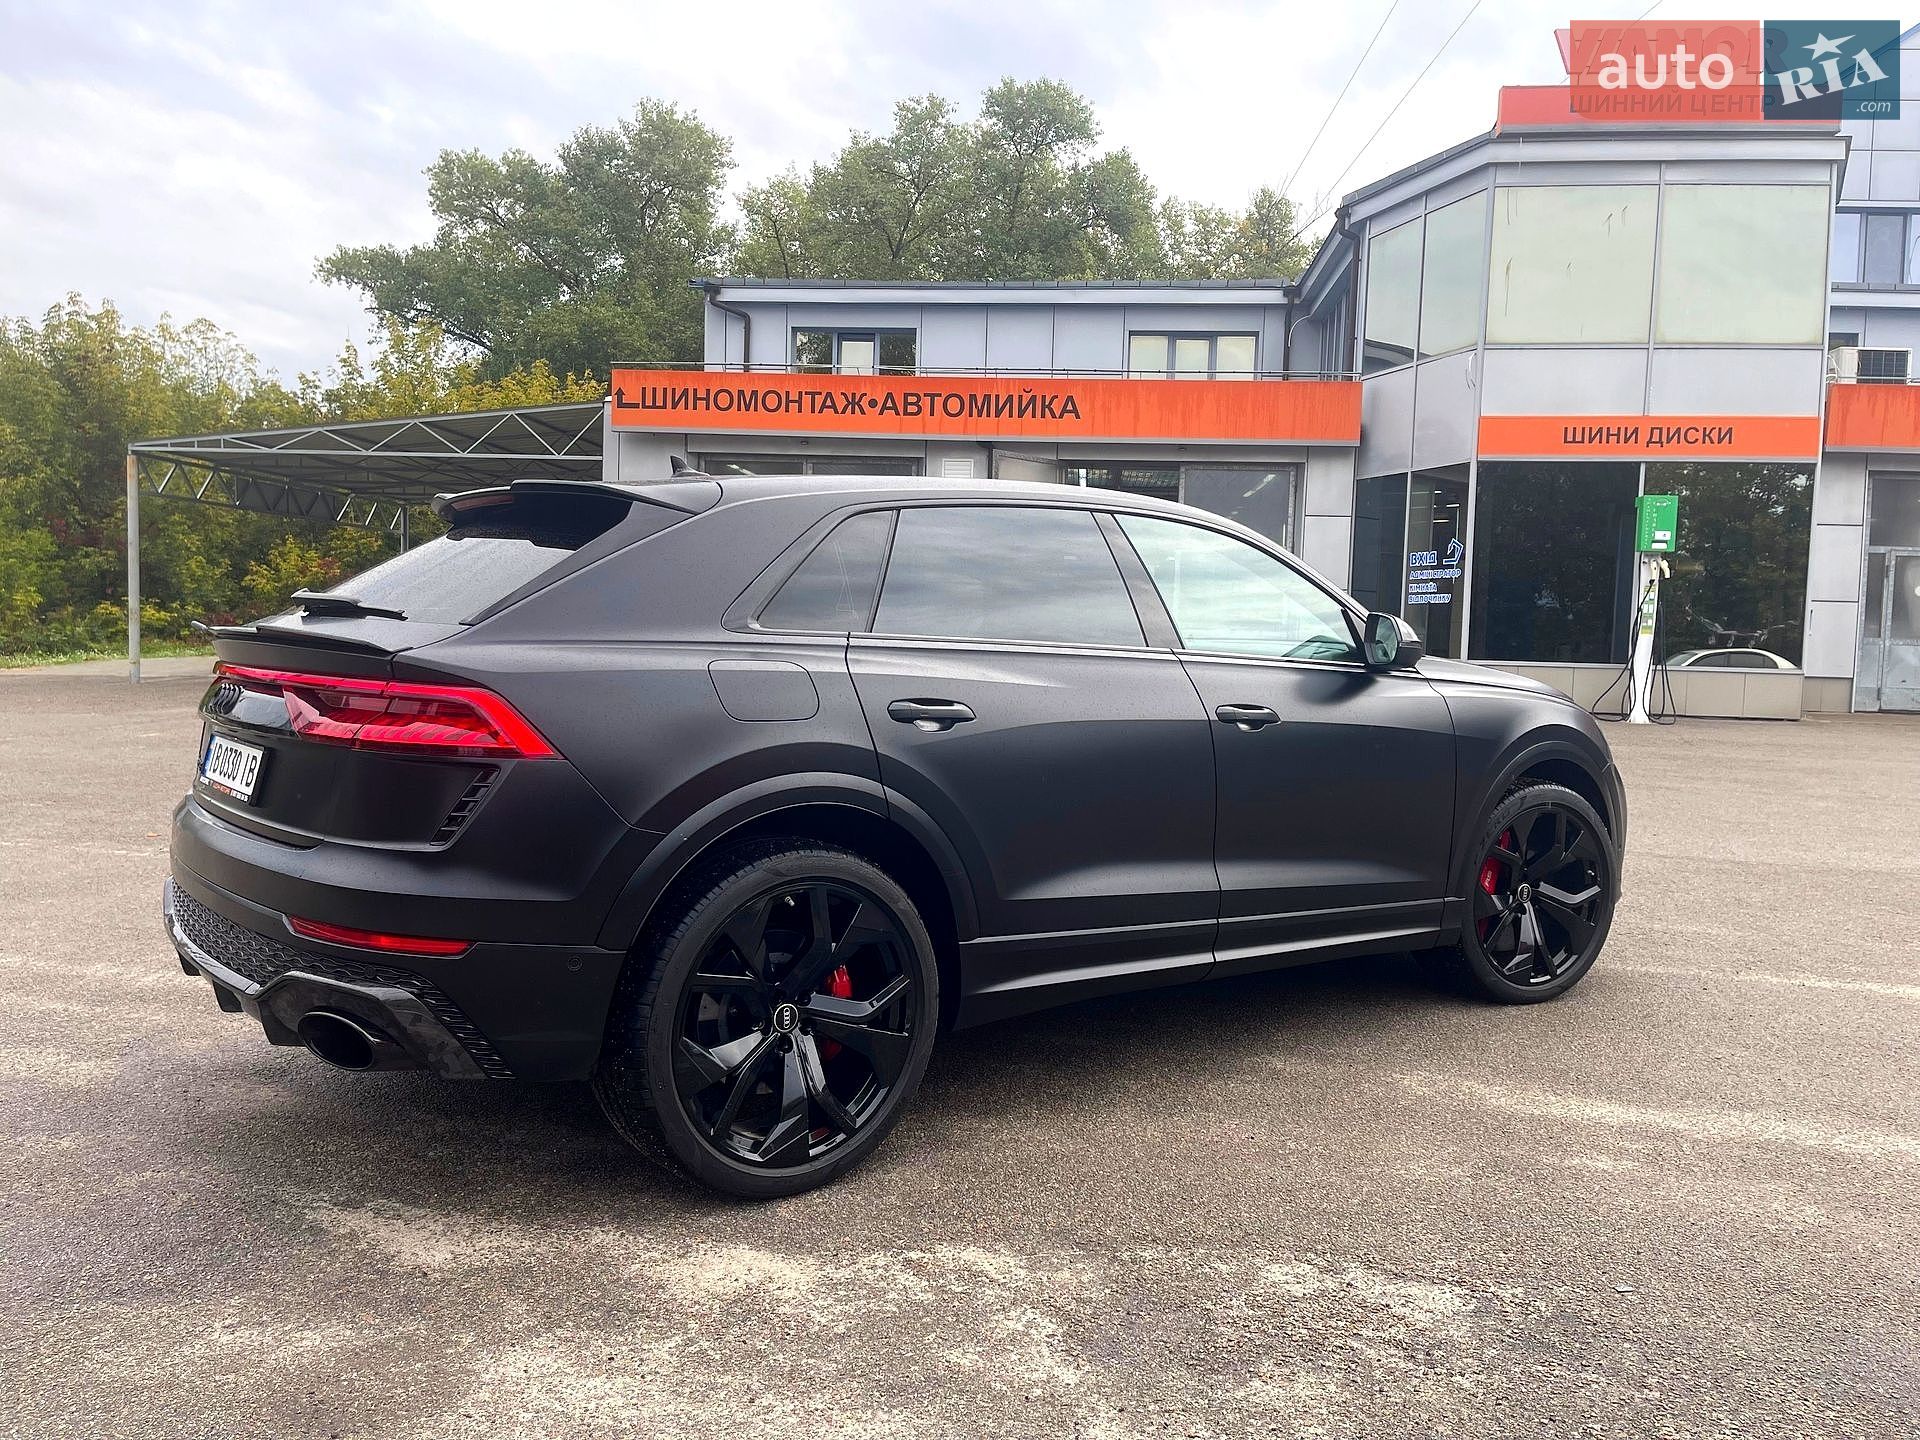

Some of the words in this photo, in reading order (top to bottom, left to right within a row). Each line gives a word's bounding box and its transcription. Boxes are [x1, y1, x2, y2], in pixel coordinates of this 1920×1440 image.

[1569, 88, 1682, 114] ШИННИЙ
[1563, 426, 1640, 444] ШИНИ
[1646, 426, 1734, 448] ДИСКИ
[1409, 551, 1437, 566] ВХІД
